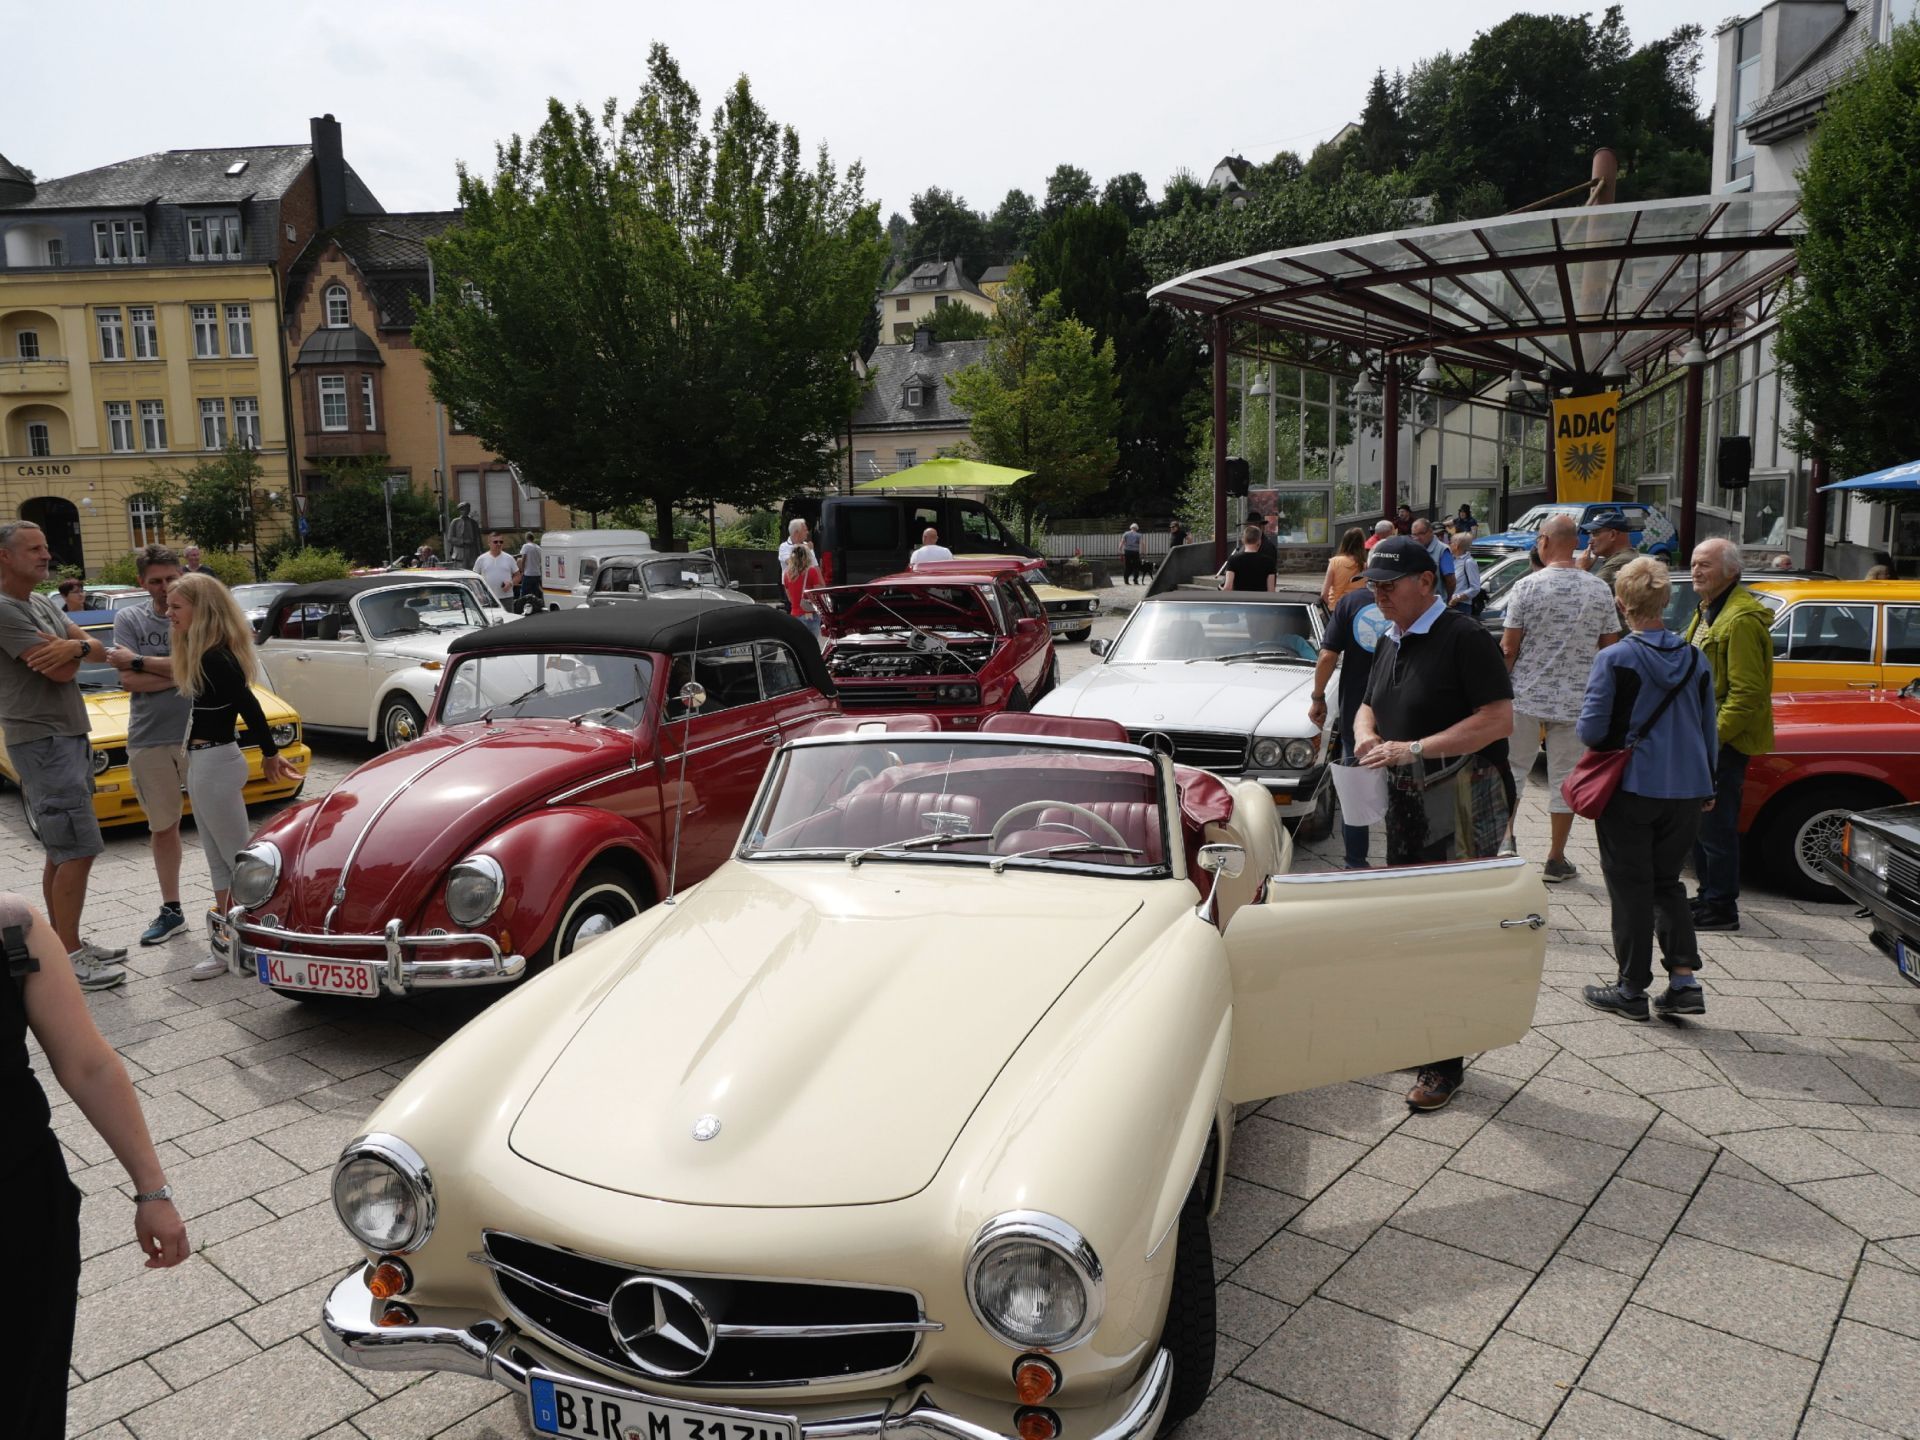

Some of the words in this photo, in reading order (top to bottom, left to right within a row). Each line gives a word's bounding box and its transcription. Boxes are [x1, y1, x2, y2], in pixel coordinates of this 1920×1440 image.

[1558, 407, 1615, 438] ADAC
[17, 464, 71, 476] CASINO
[269, 959, 293, 983] KL
[307, 963, 369, 991] 07538
[555, 1390, 622, 1440] BIR
[648, 1411, 670, 1440] M
